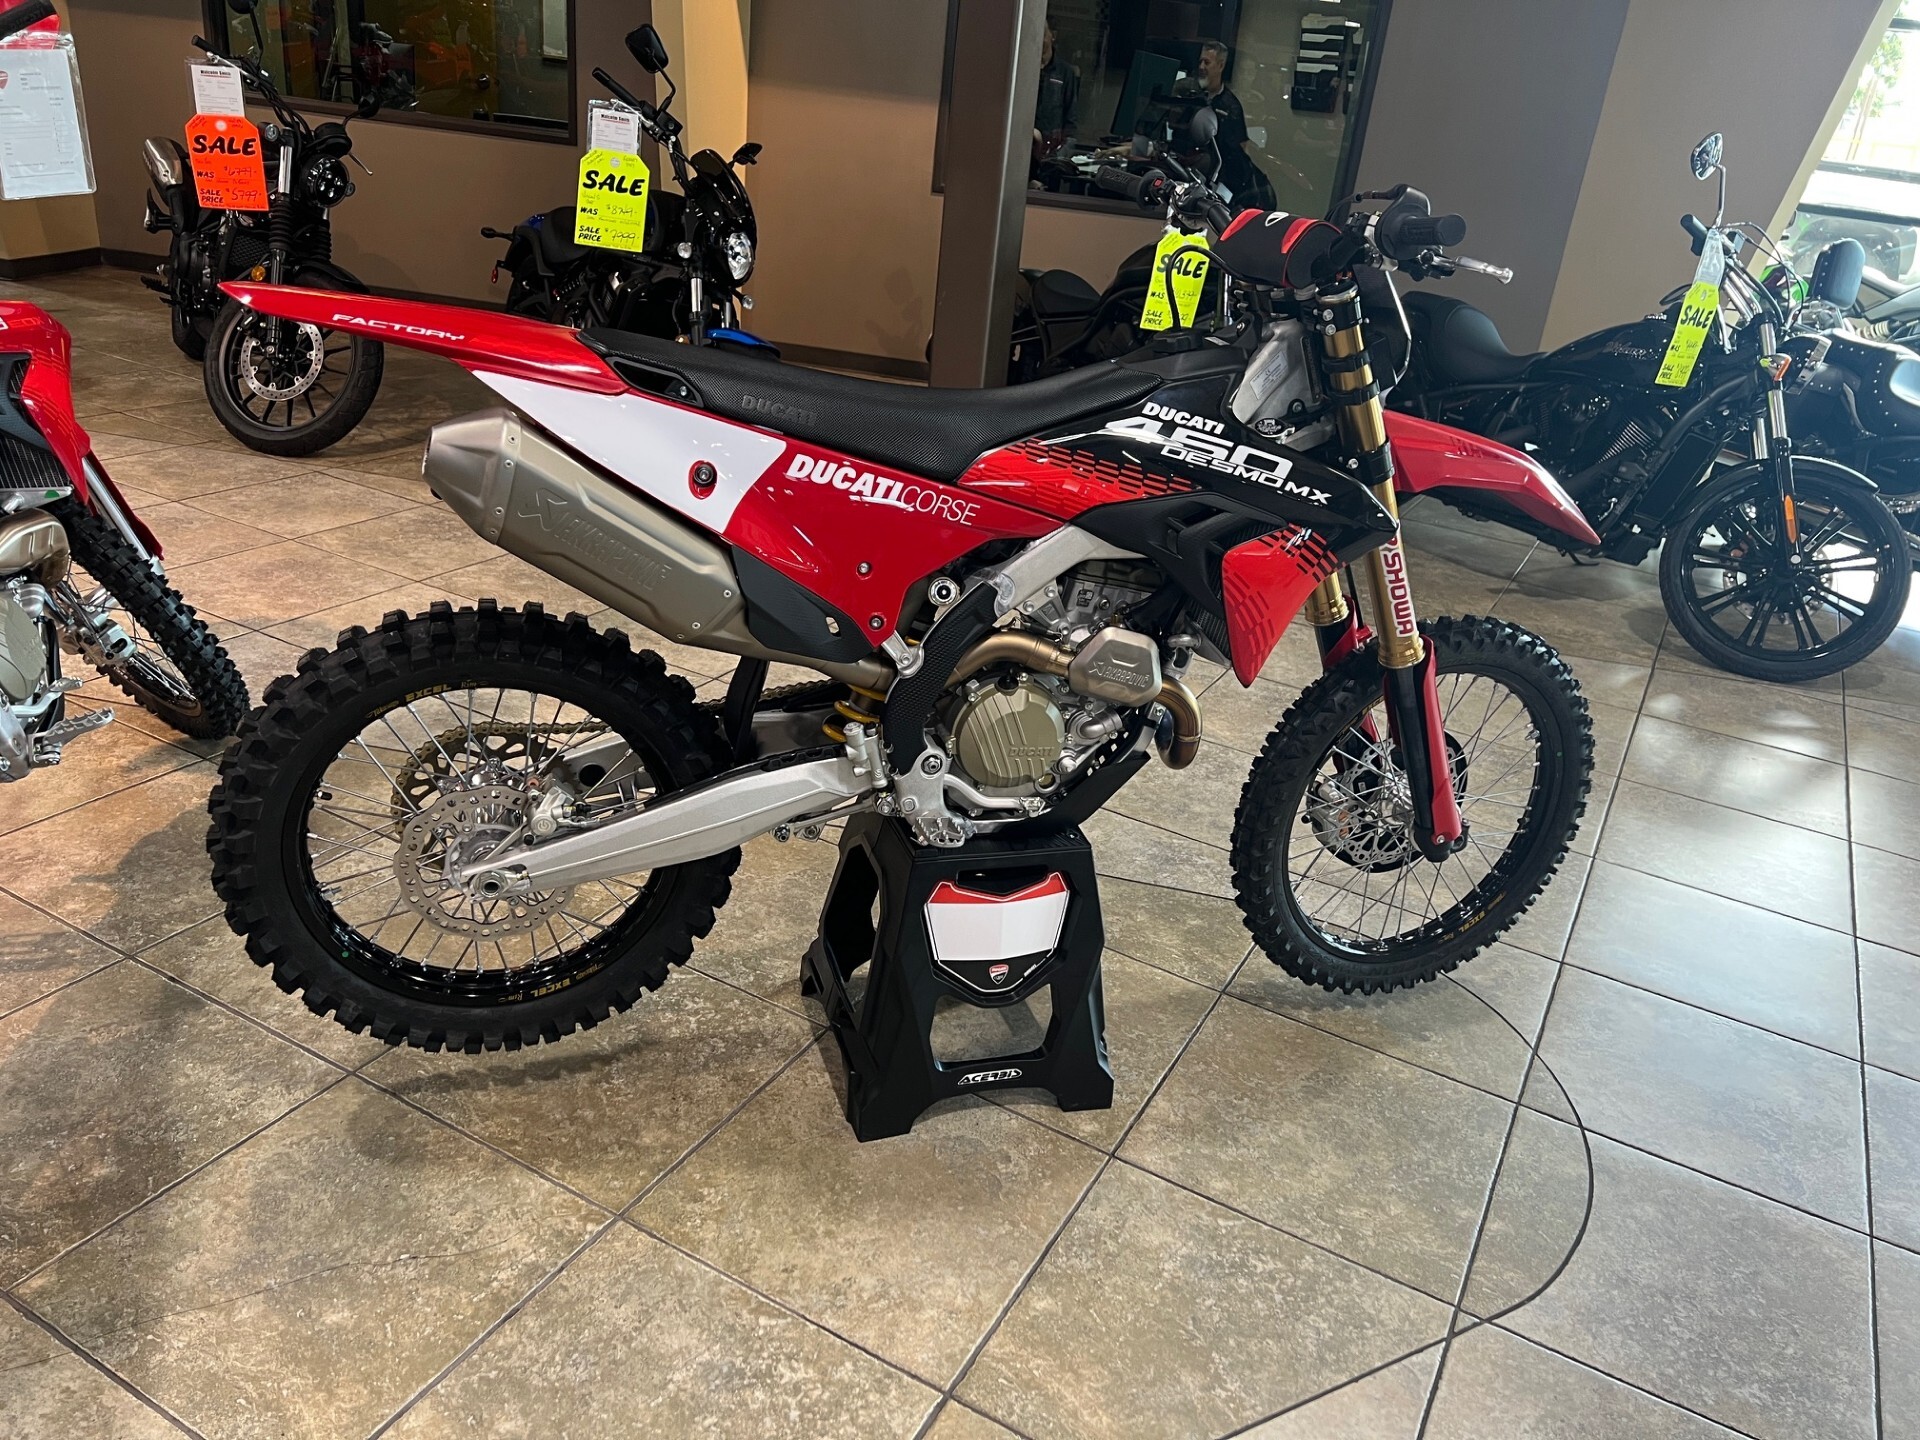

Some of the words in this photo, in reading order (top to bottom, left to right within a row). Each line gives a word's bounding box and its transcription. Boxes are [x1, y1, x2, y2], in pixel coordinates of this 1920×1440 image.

[192, 134, 256, 155] SALE
[200, 188, 221, 197] SALE
[583, 170, 645, 196] SALE
[580, 206, 598, 215] WAS
[578, 233, 602, 242] PRICE
[579, 225, 600, 234] SALE
[1157, 253, 1206, 278] SALE
[1150, 291, 1165, 299] WAS
[1144, 317, 1162, 326] PRICE
[1146, 310, 1163, 318] SALE
[1681, 305, 1713, 329] SALE
[332, 313, 465, 341] FACTORY
[741, 394, 818, 427] DUCATI
[1142, 402, 1225, 434] DUCATI
[1105, 416, 1293, 479] 450
[1161, 444, 1286, 488] DESMO
[1285, 481, 1332, 505] MX
[1384, 552, 1414, 635] SHOWA
[405, 684, 451, 703] EXCEL
[1008, 746, 1055, 757] DUCATI
[530, 978, 571, 997] EXCEL
[959, 1069, 1022, 1085] ACERBIS
